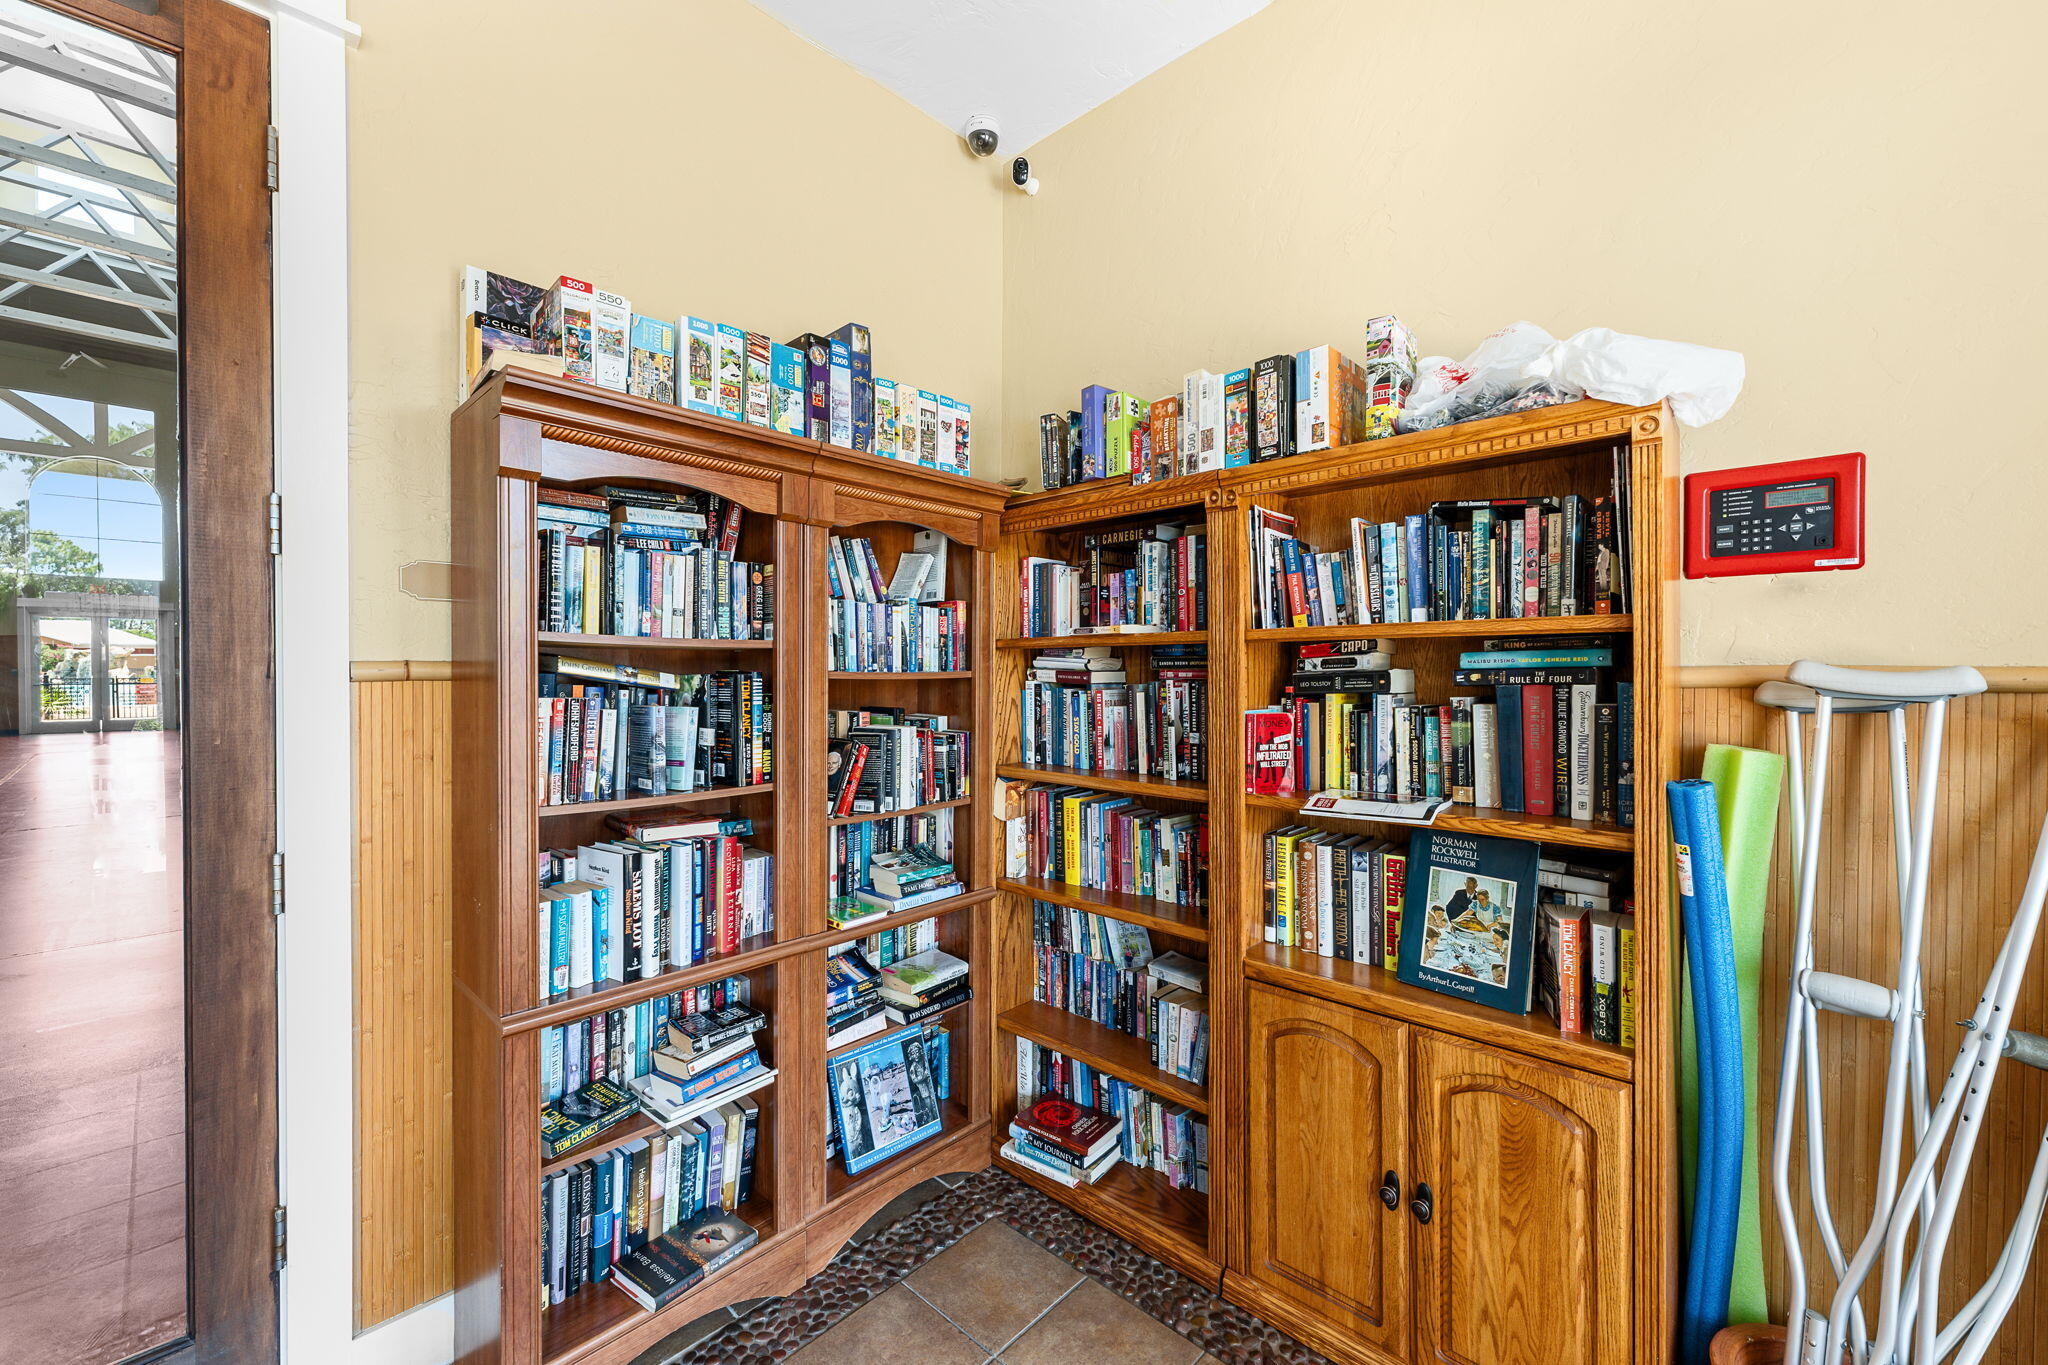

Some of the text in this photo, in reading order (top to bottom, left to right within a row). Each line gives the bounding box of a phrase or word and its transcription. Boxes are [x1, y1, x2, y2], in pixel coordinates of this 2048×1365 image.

[566, 279, 585, 291] 500
[598, 292, 623, 306] 550
[491, 320, 528, 335] CLICK
[692, 320, 709, 331] 1000
[722, 326, 741, 338] 1000
[832, 355, 849, 366] 1000
[1260, 359, 1274, 370] 1000
[878, 379, 893, 388] 1000
[1228, 372, 1244, 383] 1000
[1187, 433, 1196, 452] 500
[636, 538, 664, 550] LEE CHILD
[1101, 528, 1145, 545] CARNEGIE
[551, 544, 562, 577] TED BELL
[1369, 571, 1381, 612] COUNSELORS
[718, 606, 730, 638] SPHERE
[1340, 640, 1368, 653] CAPO
[561, 660, 612, 673] JOHN GRISHAM
[1467, 657, 1492, 665] MALIBU
[1517, 654, 1589, 664] TAYLOR JENKINS REID
[741, 679, 751, 738] TOM CLANCY
[1530, 696, 1539, 713] POINT
[1479, 707, 1492, 749] Trigiani
[1531, 714, 1540, 722] OF
[1557, 700, 1567, 754] JULIE GARWOOD
[570, 700, 580, 761] JOHN SANDFORD
[586, 717, 597, 748] LEE CHILD
[1441, 723, 1452, 763] JOHN GRISHAM
[762, 749, 771, 773] NANO
[1577, 734, 1589, 786] TOGETHERNESS
[1556, 757, 1568, 803] WIRED
[1431, 845, 1480, 861] ROCKWELL
[1432, 835, 1478, 850] NORMAN
[1278, 842, 1286, 880] RECURSION
[1334, 849, 1347, 876] PERETTI
[1430, 854, 1477, 868] ILLUSTRATOR
[624, 889, 633, 916] Stephen
[899, 899, 921, 909] DANIELLE
[1300, 861, 1309, 929] BUSINESS WISDOM
[1309, 910, 1316, 921] OF
[1386, 858, 1405, 957] Griffin Hunters
[1336, 907, 1348, 947] VISITATION
[558, 916, 568, 964] SUSAN MALLERY
[1563, 923, 1573, 976] TOM CLANCY
[1418, 971, 1475, 994] By Arthur L. Guptill
[1599, 996, 1607, 1019] BOX
[587, 1090, 615, 1106] TARGET
[592, 1083, 626, 1103] ACQUIRED
[554, 1123, 599, 1152] TOM CLANCY
[1033, 1138, 1074, 1164] MY JOURNEY
[582, 1175, 592, 1214] COLSON
[637, 1167, 646, 1199] Healing
[637, 1205, 645, 1235] Voltage
[632, 1251, 677, 1285] Melissa Bank
